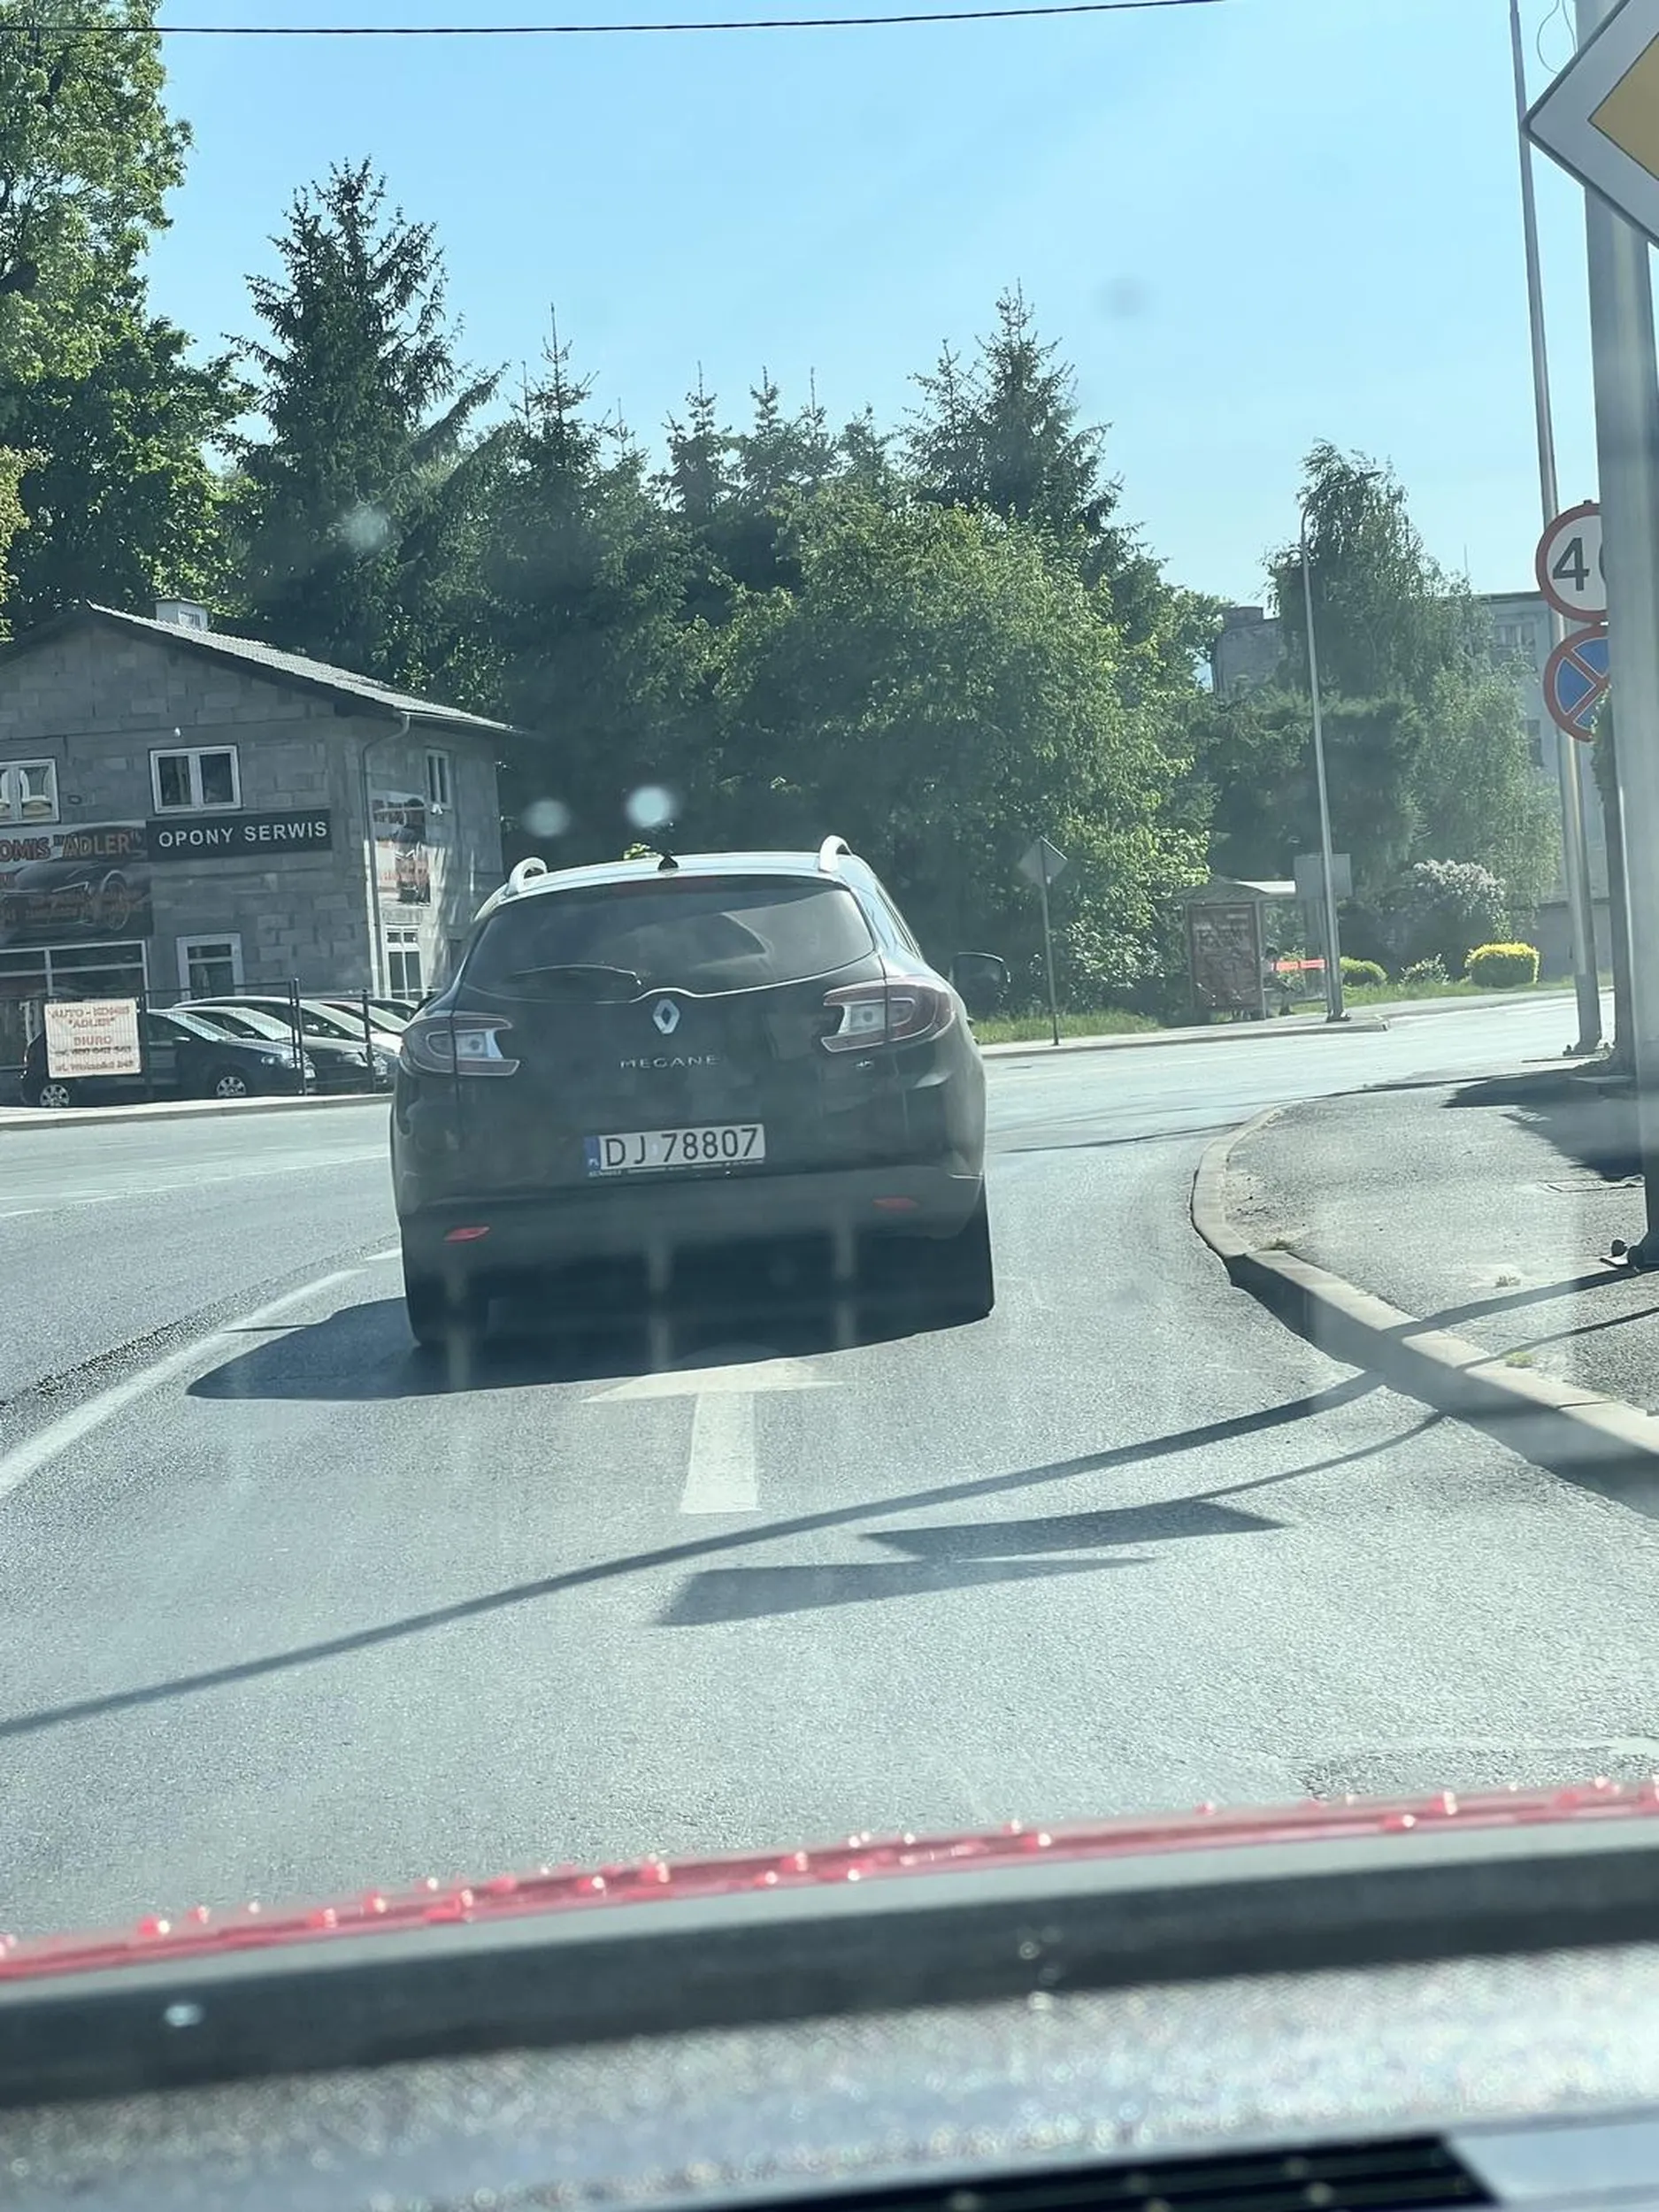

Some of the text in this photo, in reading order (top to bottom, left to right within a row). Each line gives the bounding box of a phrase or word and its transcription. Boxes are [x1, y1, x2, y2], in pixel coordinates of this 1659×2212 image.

[1552, 536, 1605, 592] 4
[158, 820, 327, 848] OPONY SERWIS
[605, 1127, 757, 1166] DJ 78807
